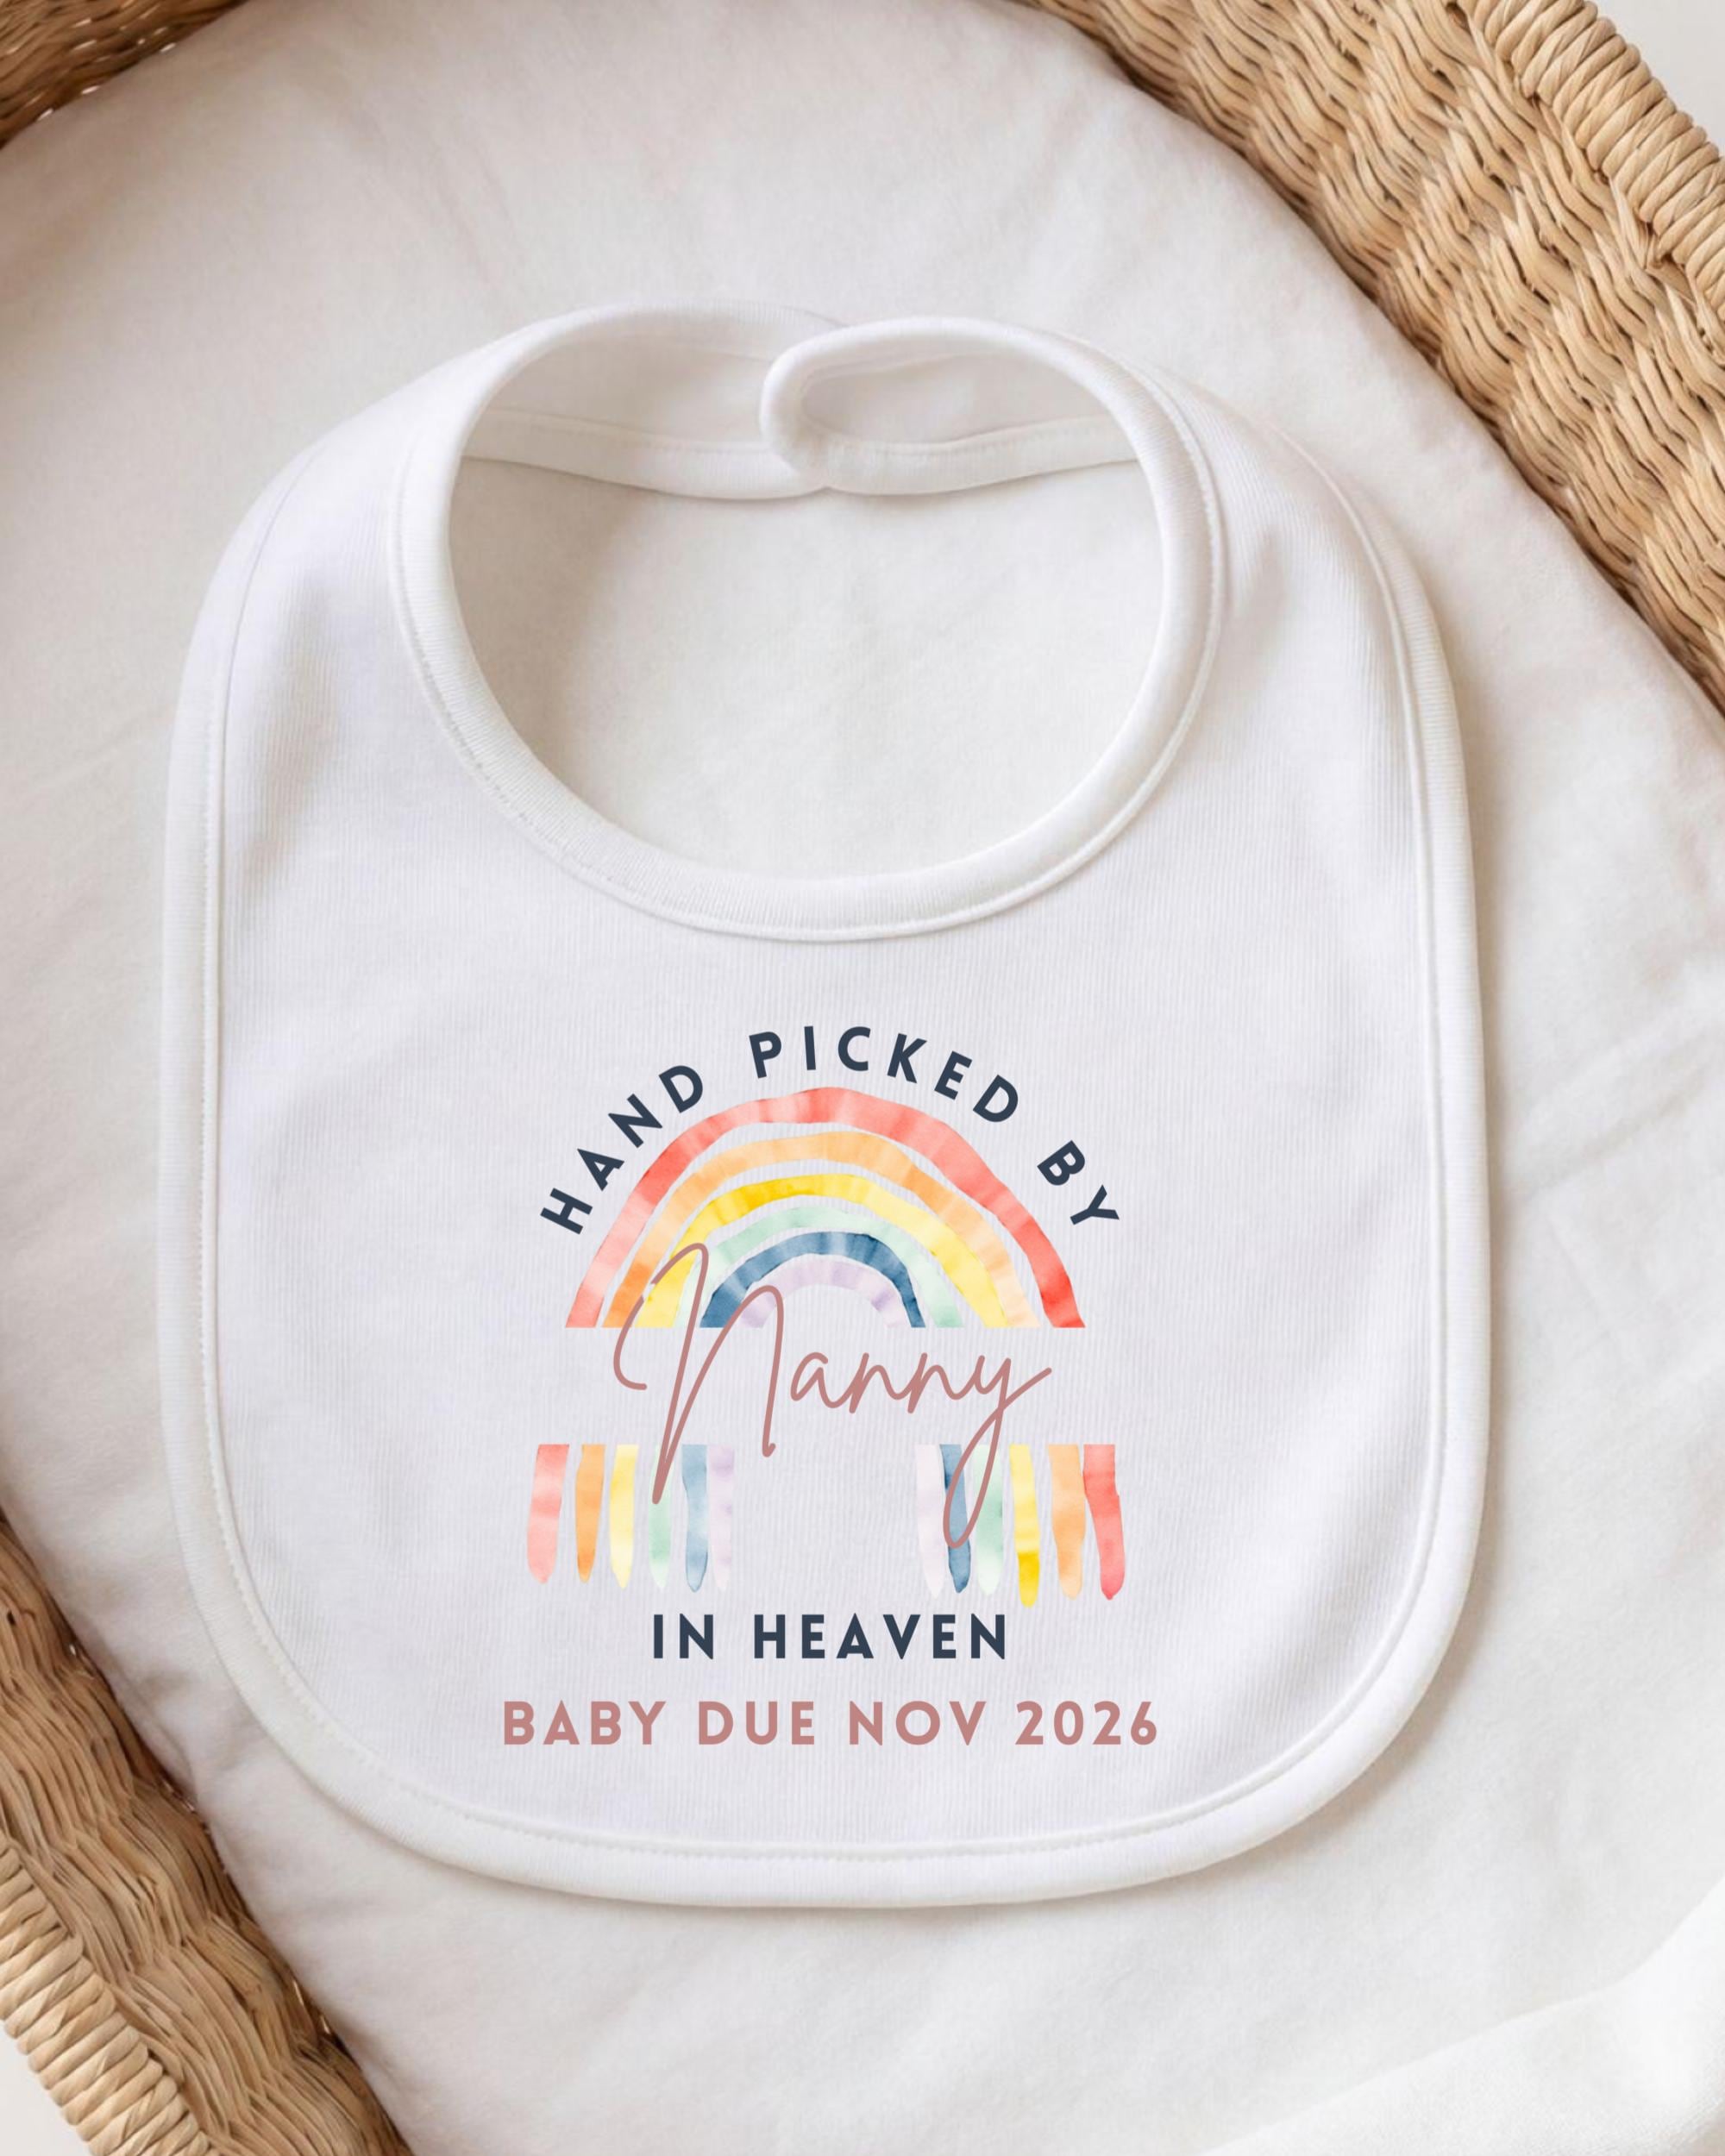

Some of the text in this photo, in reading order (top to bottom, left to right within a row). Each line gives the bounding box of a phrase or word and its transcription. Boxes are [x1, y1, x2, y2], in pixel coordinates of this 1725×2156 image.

[540, 1025, 1120, 1235] HAND PICKED BY
[612, 1242, 1053, 1550] Nanny
[653, 1613, 1007, 1660] IN HEAVEN
[504, 1700, 1157, 1746] BABY DUE NOV 2026
